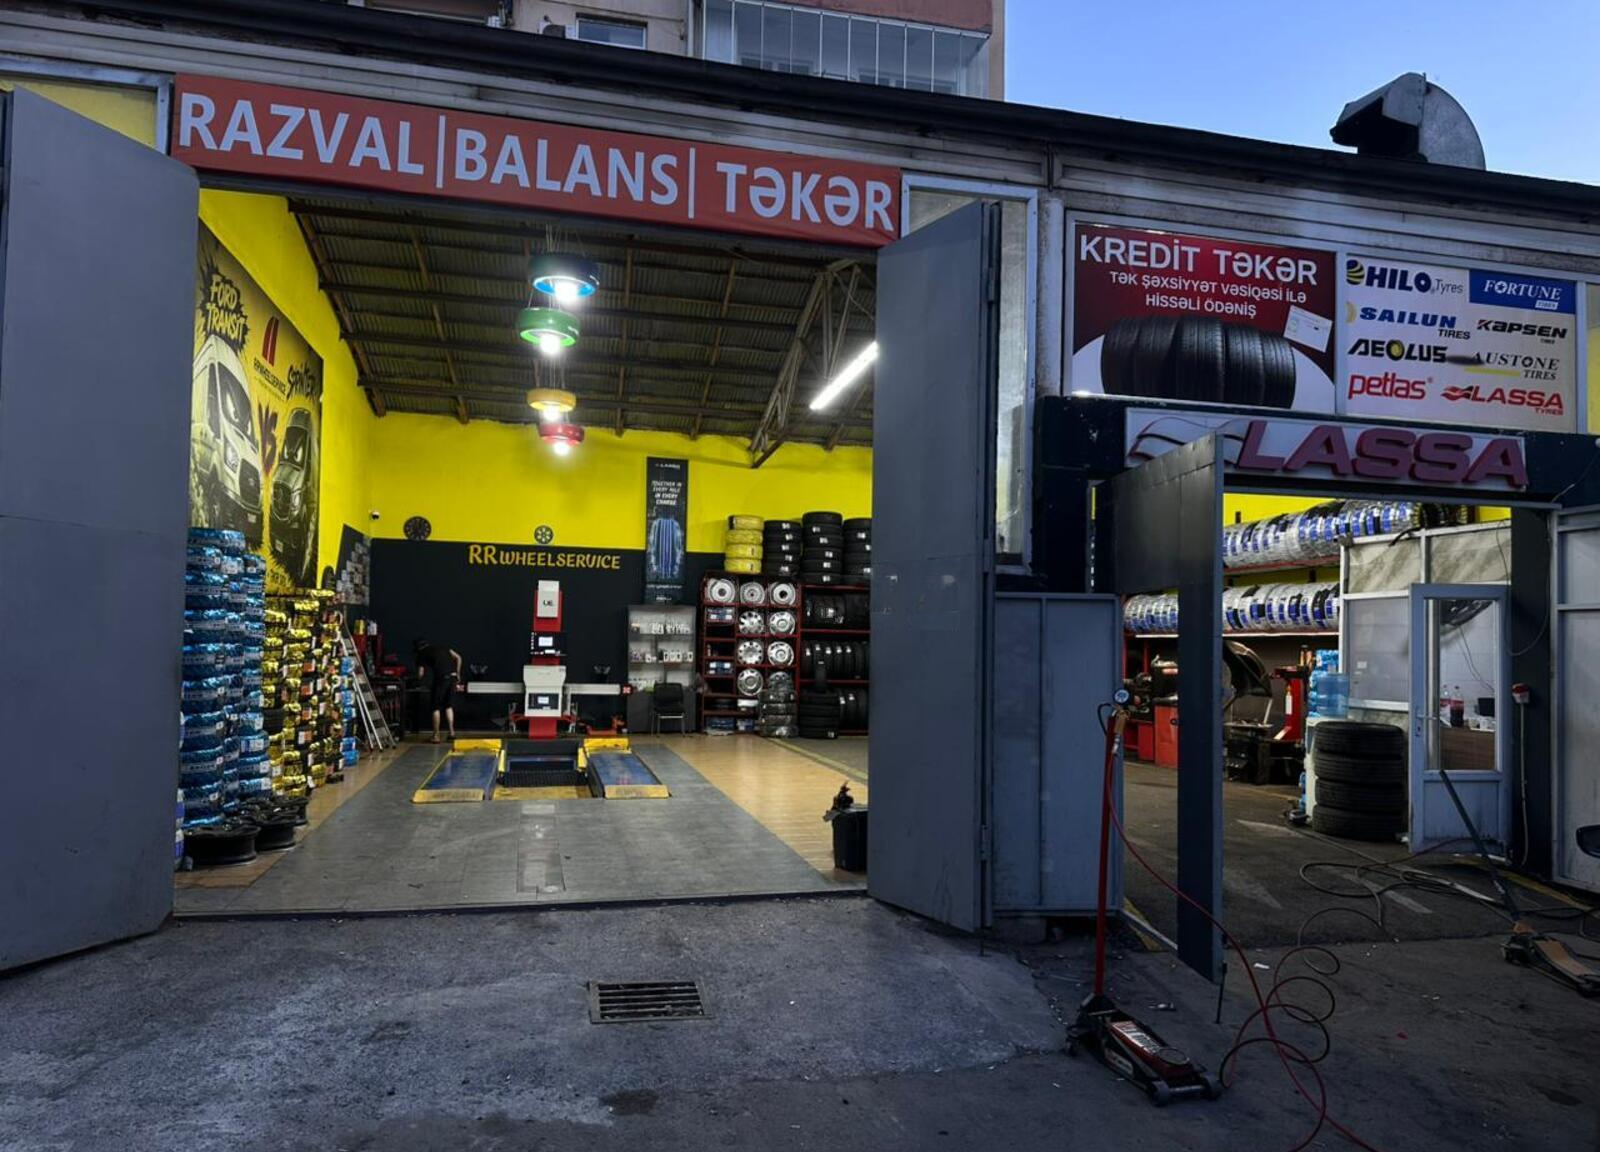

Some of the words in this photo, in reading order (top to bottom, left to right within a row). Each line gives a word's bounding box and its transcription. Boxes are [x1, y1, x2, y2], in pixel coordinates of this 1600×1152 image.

[178, 92, 425, 176] RAZVAL
[454, 127, 679, 206] BALANS
[716, 161, 895, 232] TƏKƏR
[1080, 234, 1201, 273] KREDİT
[1212, 249, 1318, 286] TƏKƏR
[1109, 271, 1138, 286] TƏK
[1365, 265, 1432, 293] HILO
[1434, 278, 1464, 295] Tyres
[1483, 279, 1563, 301] FORTUNE
[209, 273, 238, 310] FORD
[1145, 292, 1201, 311] HİSSƏLİ
[1204, 297, 1257, 320] ÖDƏNİŞ
[1359, 306, 1457, 329] SAILUN
[1437, 328, 1471, 340] TIRES
[1347, 338, 1448, 363] AEOLUS
[1471, 351, 1560, 371] AUSTONE
[1347, 371, 1427, 400] petlas
[1523, 369, 1557, 380] TIRES
[1470, 385, 1564, 409] LASSA
[1236, 420, 1529, 487] LASSA
[468, 544, 498, 565] RR
